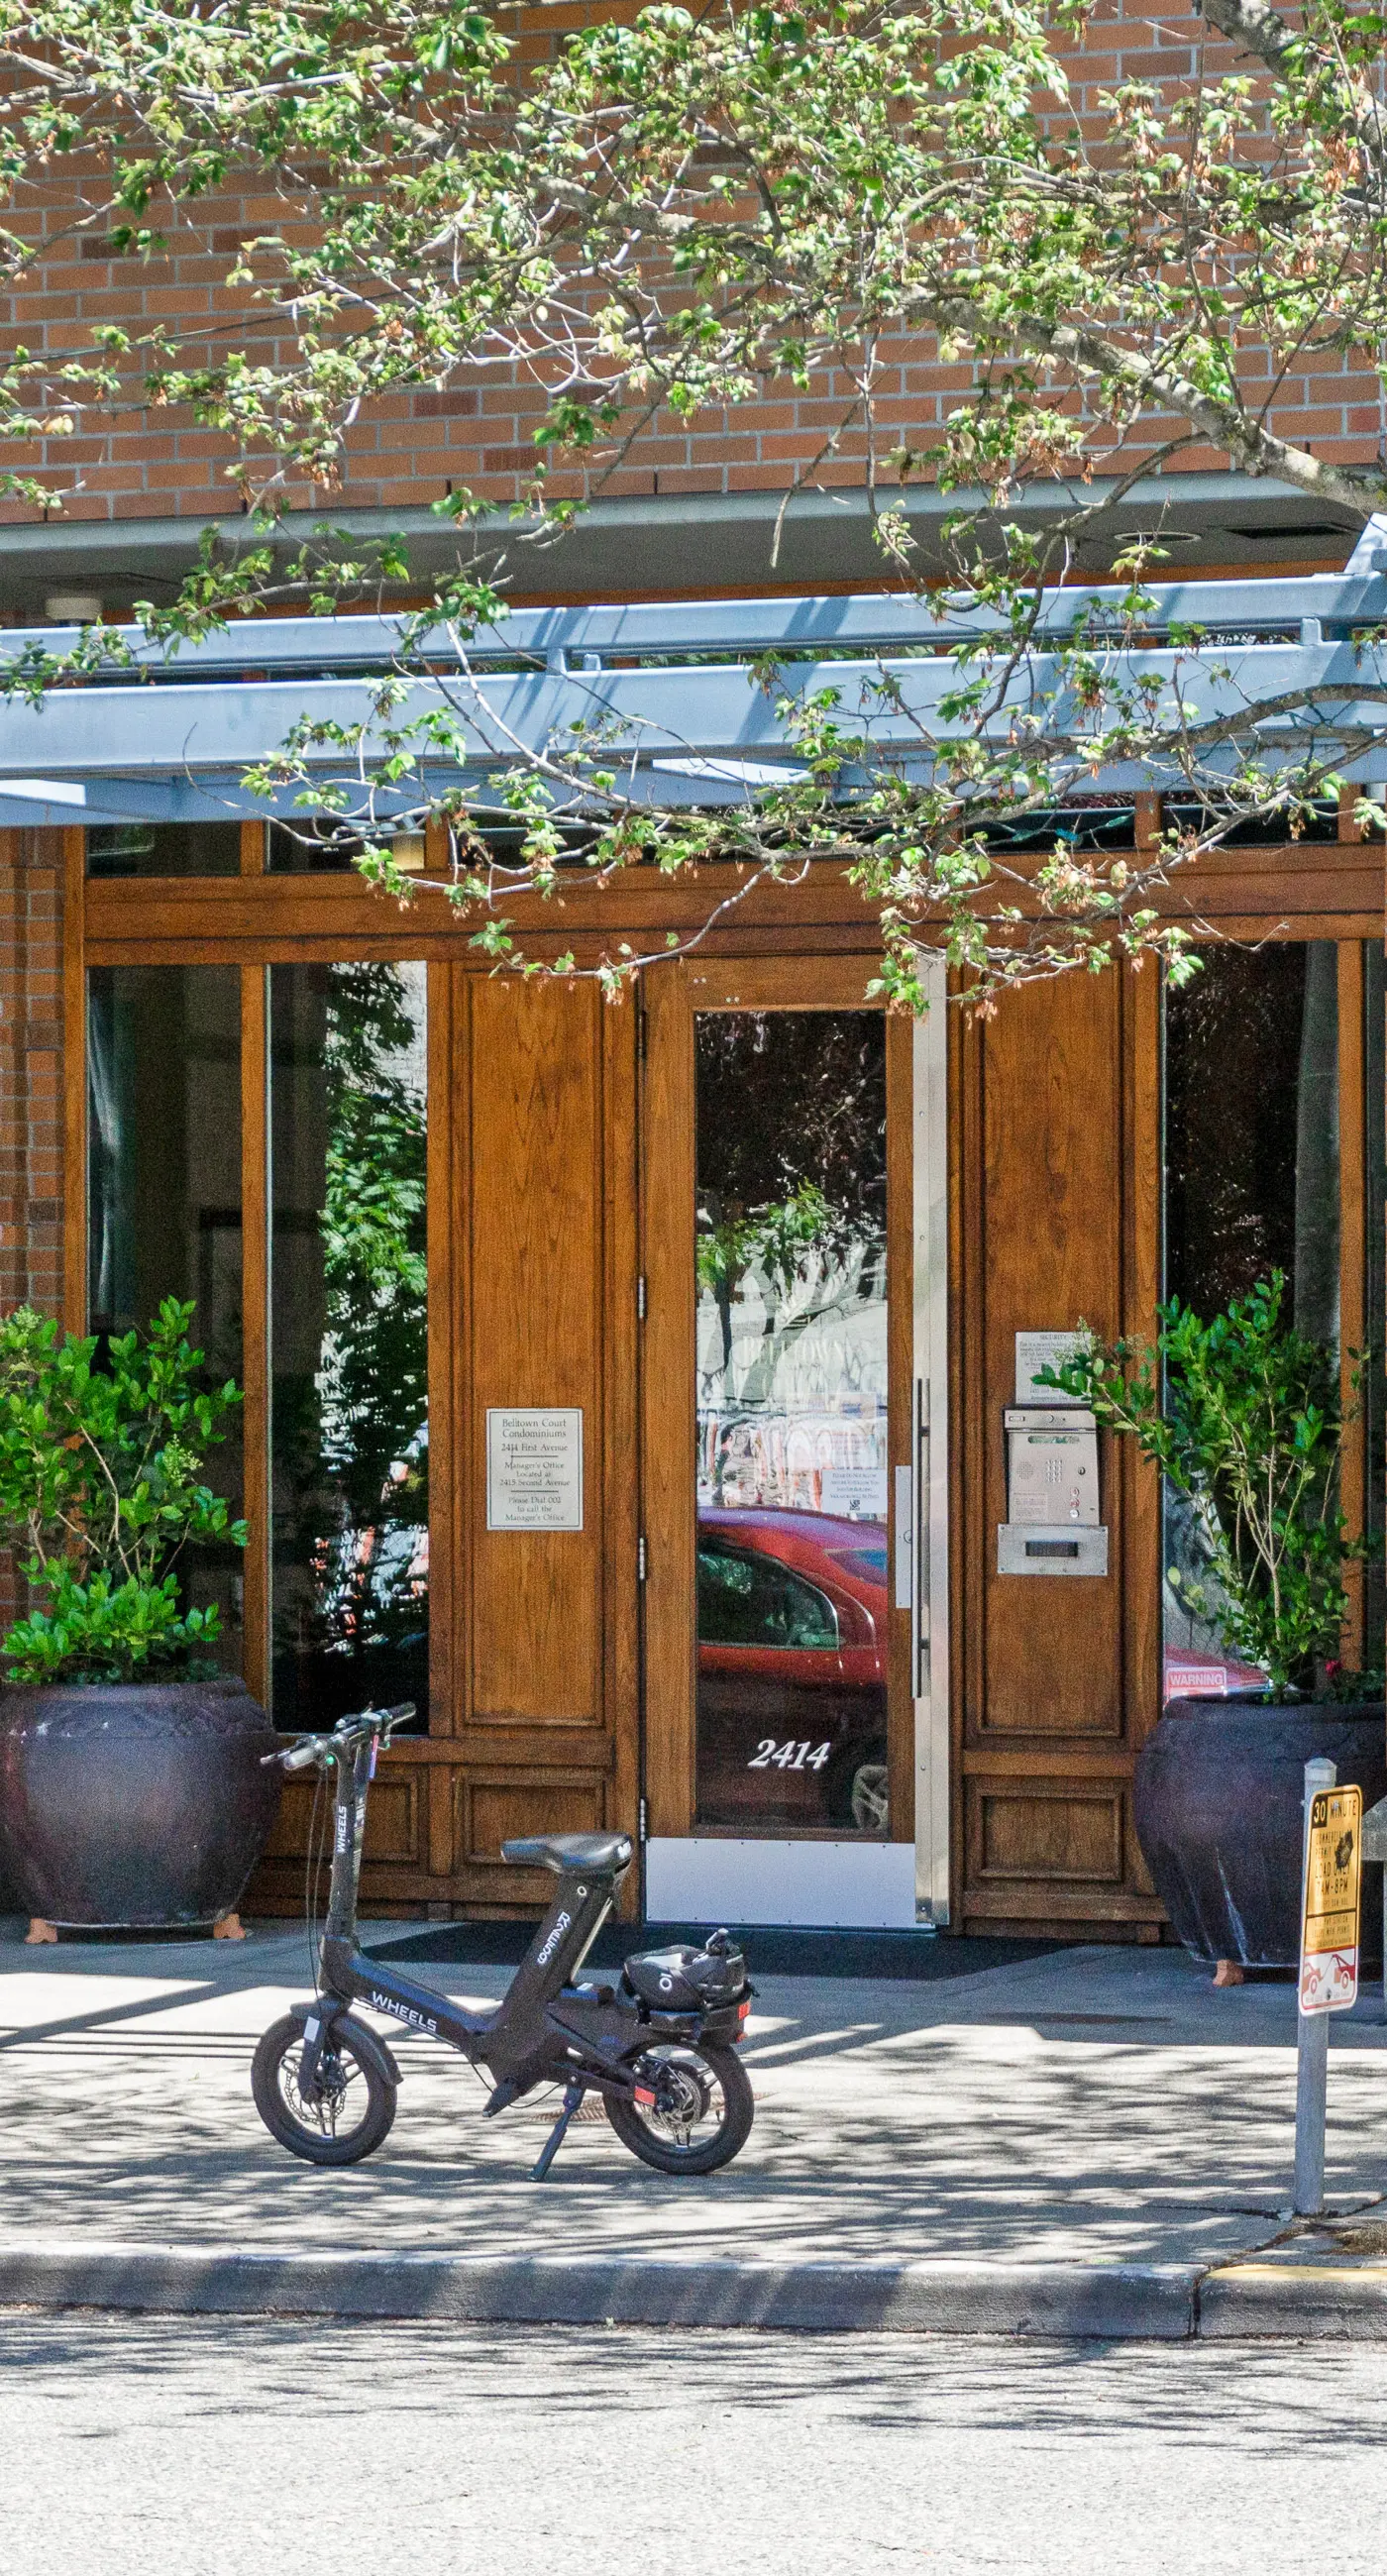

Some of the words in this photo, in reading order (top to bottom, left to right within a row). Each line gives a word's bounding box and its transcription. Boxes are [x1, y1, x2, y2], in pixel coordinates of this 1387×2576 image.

[502, 1418, 539, 1427] Belltown
[541, 1418, 567, 1427] Court
[502, 1429, 567, 1439] Condominiums
[1169, 1673, 1224, 1685] WARNING
[747, 1739, 831, 1770] 2414
[1314, 1800, 1327, 1823] 30
[1330, 1799, 1357, 1819] MINUTE
[336, 1805, 347, 1854] WHEELS
[373, 1990, 438, 2032] WHEELS
